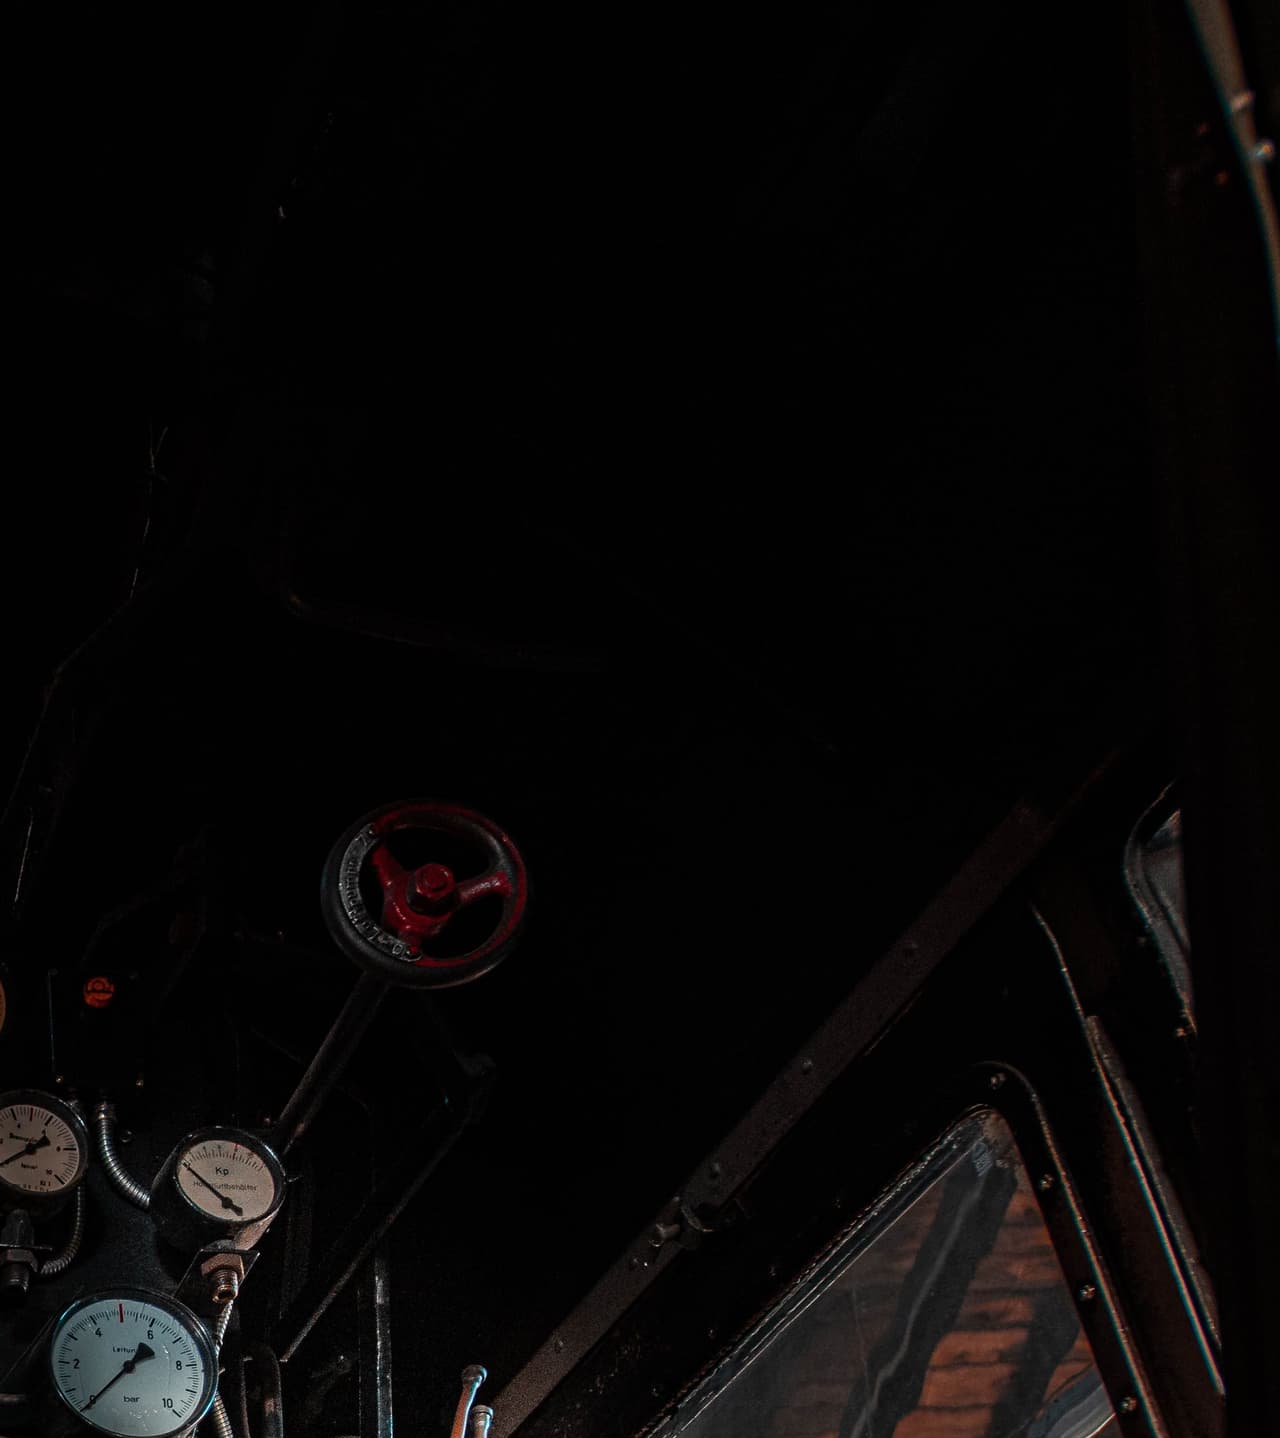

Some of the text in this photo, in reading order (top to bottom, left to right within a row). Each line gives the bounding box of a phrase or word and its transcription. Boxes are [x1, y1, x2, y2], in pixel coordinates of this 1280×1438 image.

[95, 1327, 103, 1338] 4
[147, 1329, 154, 1340] 6
[73, 1358, 80, 1369] 2
[175, 1360, 183, 1371] 8
[123, 1395, 140, 1403] bar
[162, 1397, 174, 1409] 10
